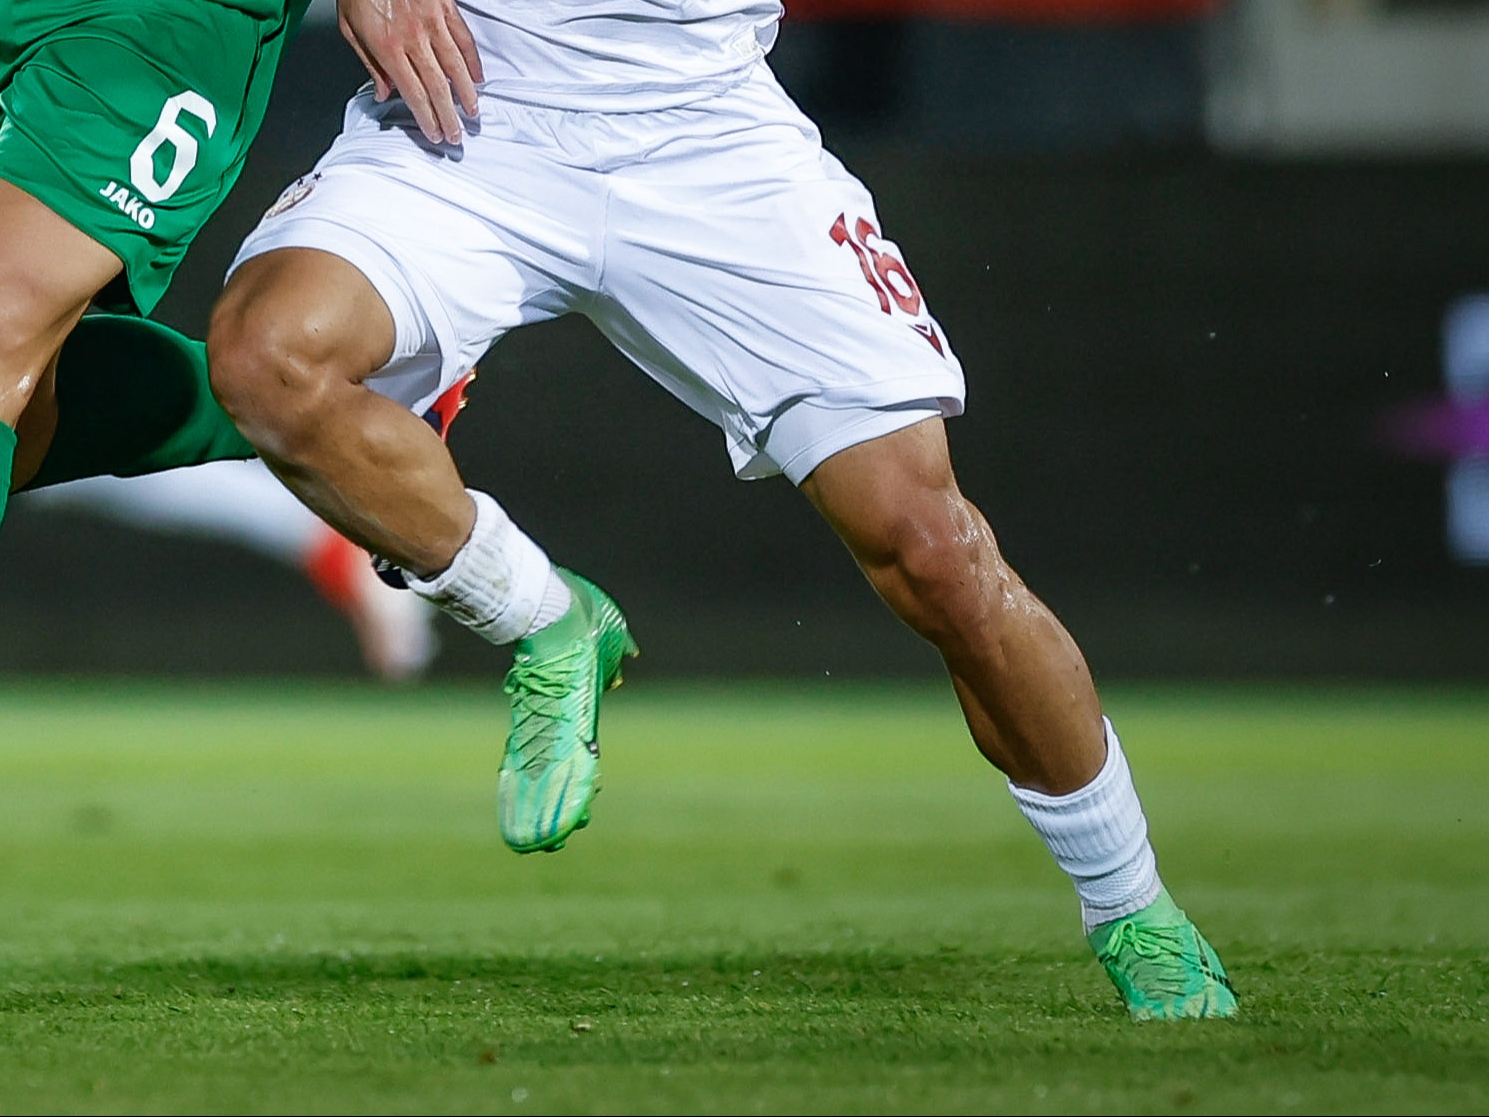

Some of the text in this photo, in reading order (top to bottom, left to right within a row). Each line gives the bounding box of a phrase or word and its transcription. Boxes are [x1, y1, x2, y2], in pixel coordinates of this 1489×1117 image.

[129, 89, 217, 203] 6
[98, 180, 156, 230] JAKO
[828, 211, 921, 317] 16
